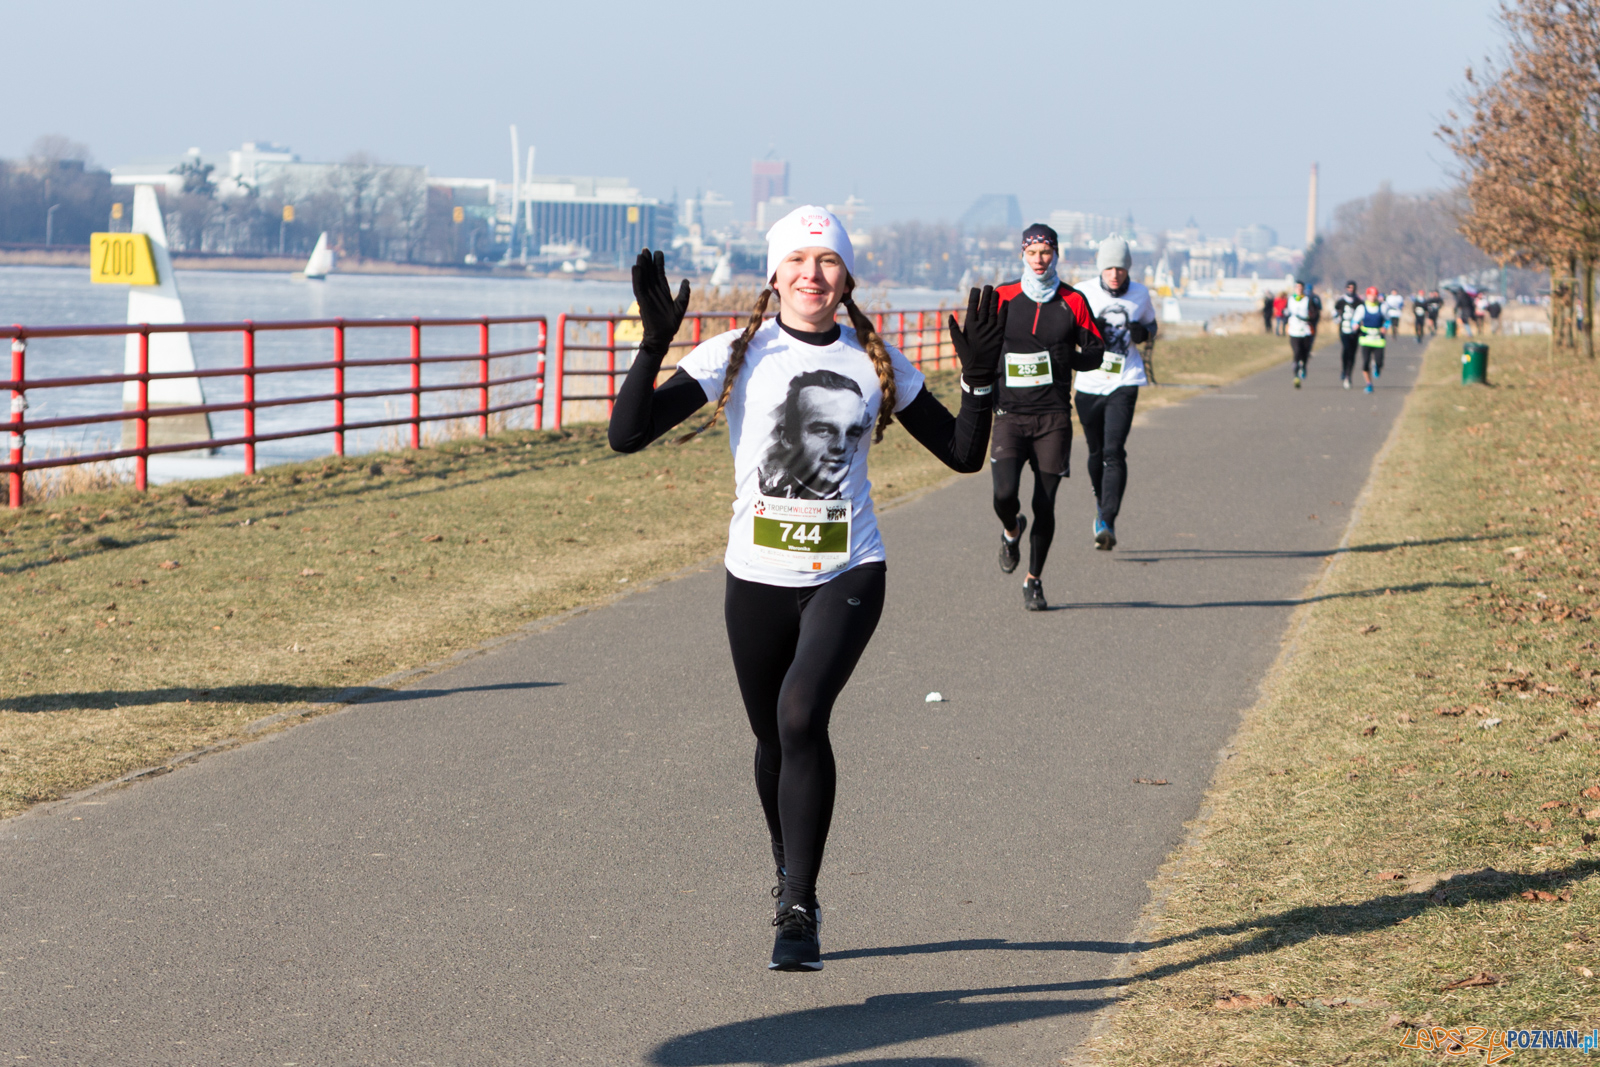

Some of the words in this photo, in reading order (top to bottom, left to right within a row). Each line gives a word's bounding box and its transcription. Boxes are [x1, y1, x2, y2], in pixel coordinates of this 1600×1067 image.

[100, 239, 135, 275] 200
[1017, 364, 1038, 375] 252
[779, 522, 822, 545] 744
